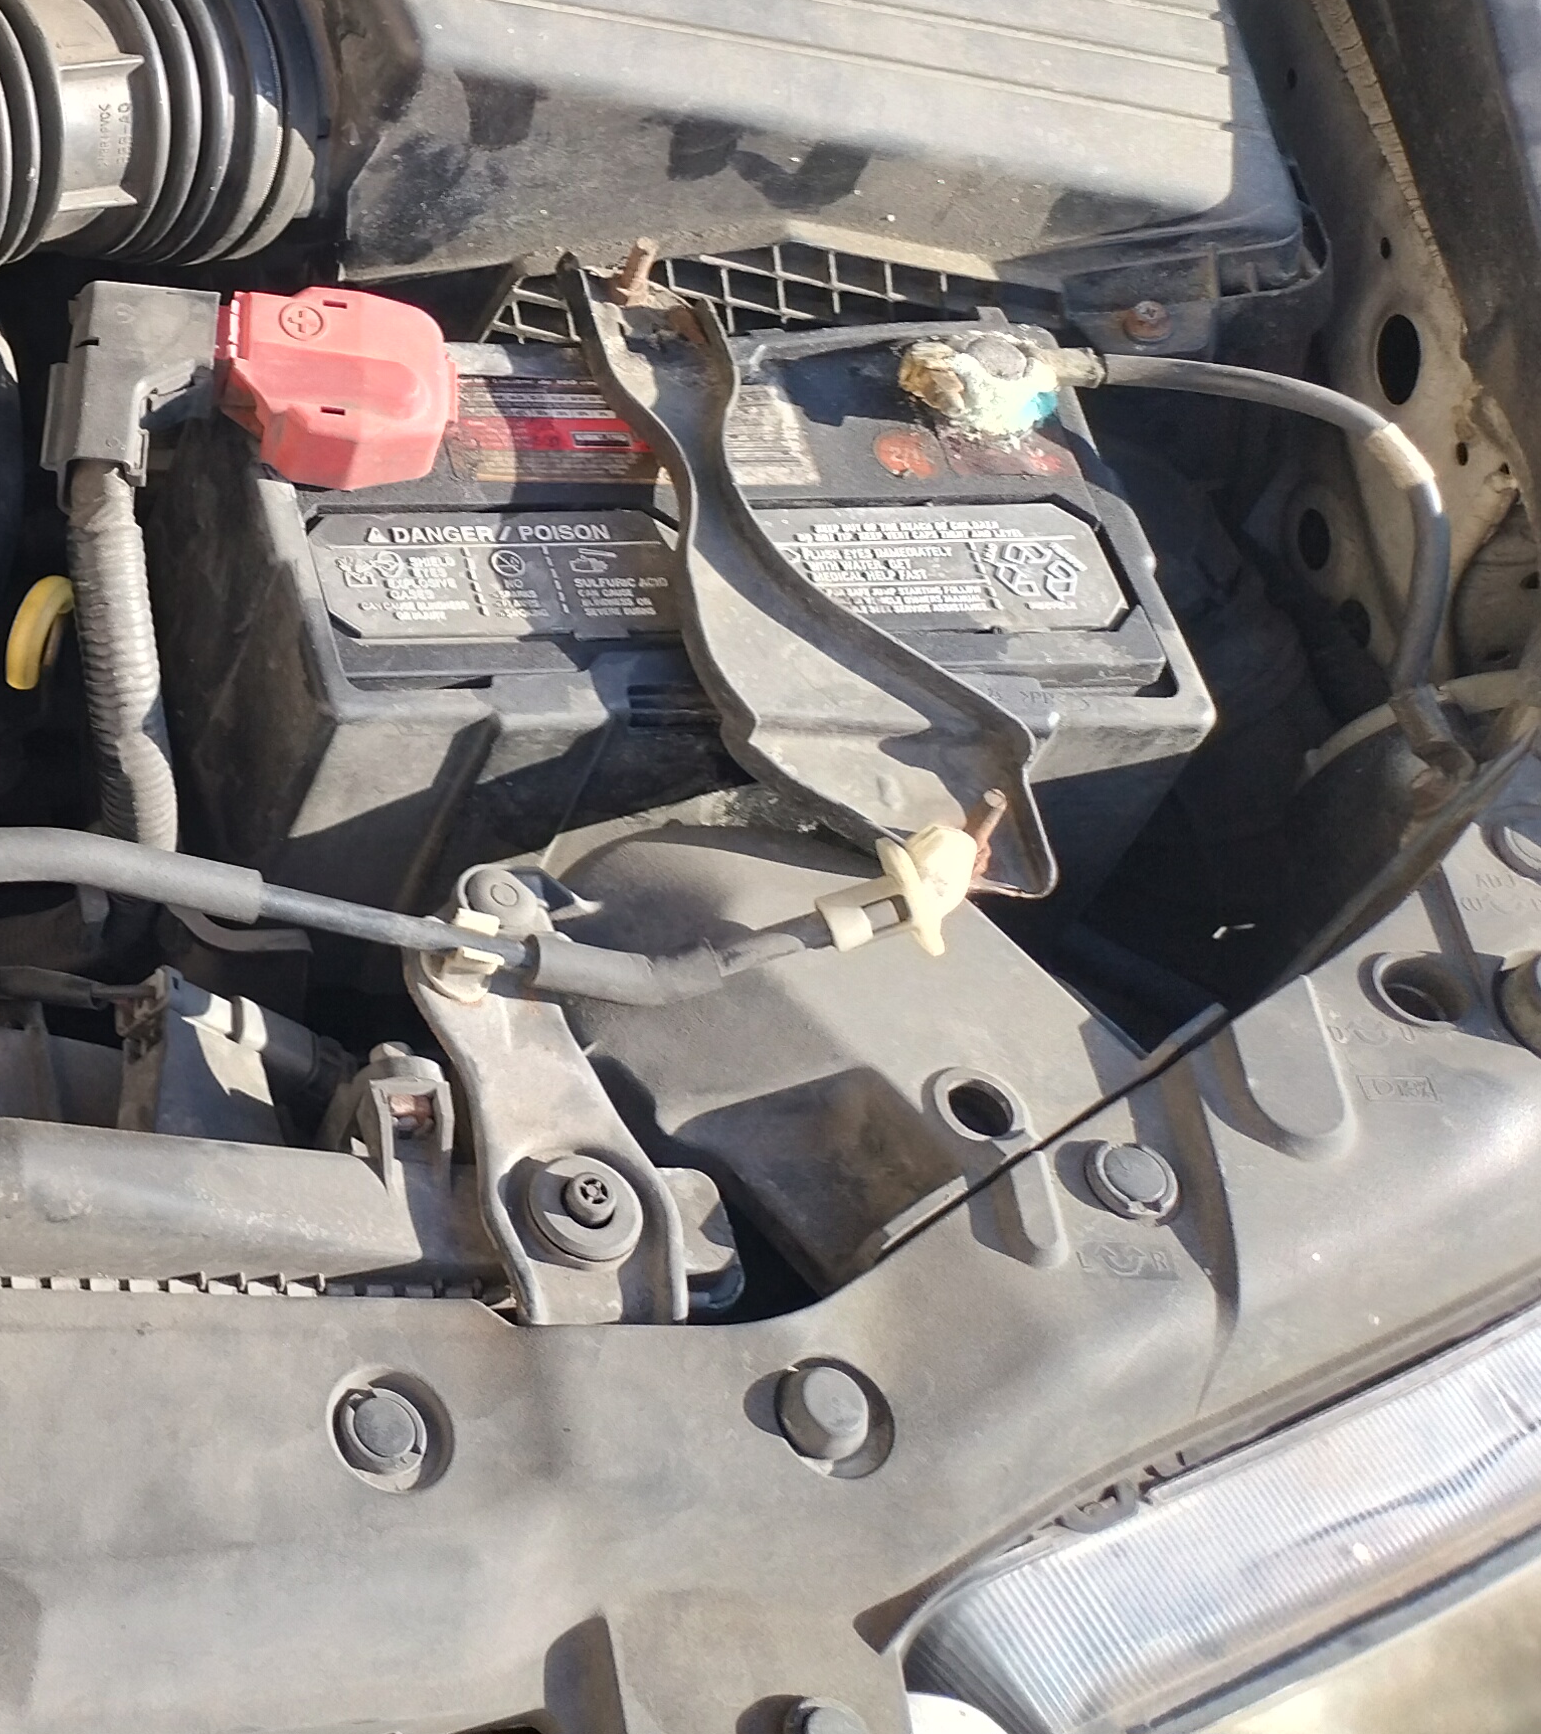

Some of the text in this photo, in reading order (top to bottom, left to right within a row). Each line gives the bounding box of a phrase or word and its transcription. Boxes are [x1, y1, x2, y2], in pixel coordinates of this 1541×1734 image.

[392, 524, 611, 543] DANGER / POISON
[802, 546, 952, 560] FLUSH EYES IMMEDIATELY
[408, 556, 456, 567] SHIELD
[806, 560, 840, 571] WITH
[888, 558, 911, 569] GET
[414, 567, 448, 578] EYES
[813, 569, 928, 583] MEDICAL HELP FAST
[387, 578, 458, 589] EXPLOSIVE
[504, 578, 524, 589] NO
[573, 576, 669, 588] SULFURIC ACID
[390, 589, 435, 600] GASES
[577, 588, 634, 598] CAN CAUSE
